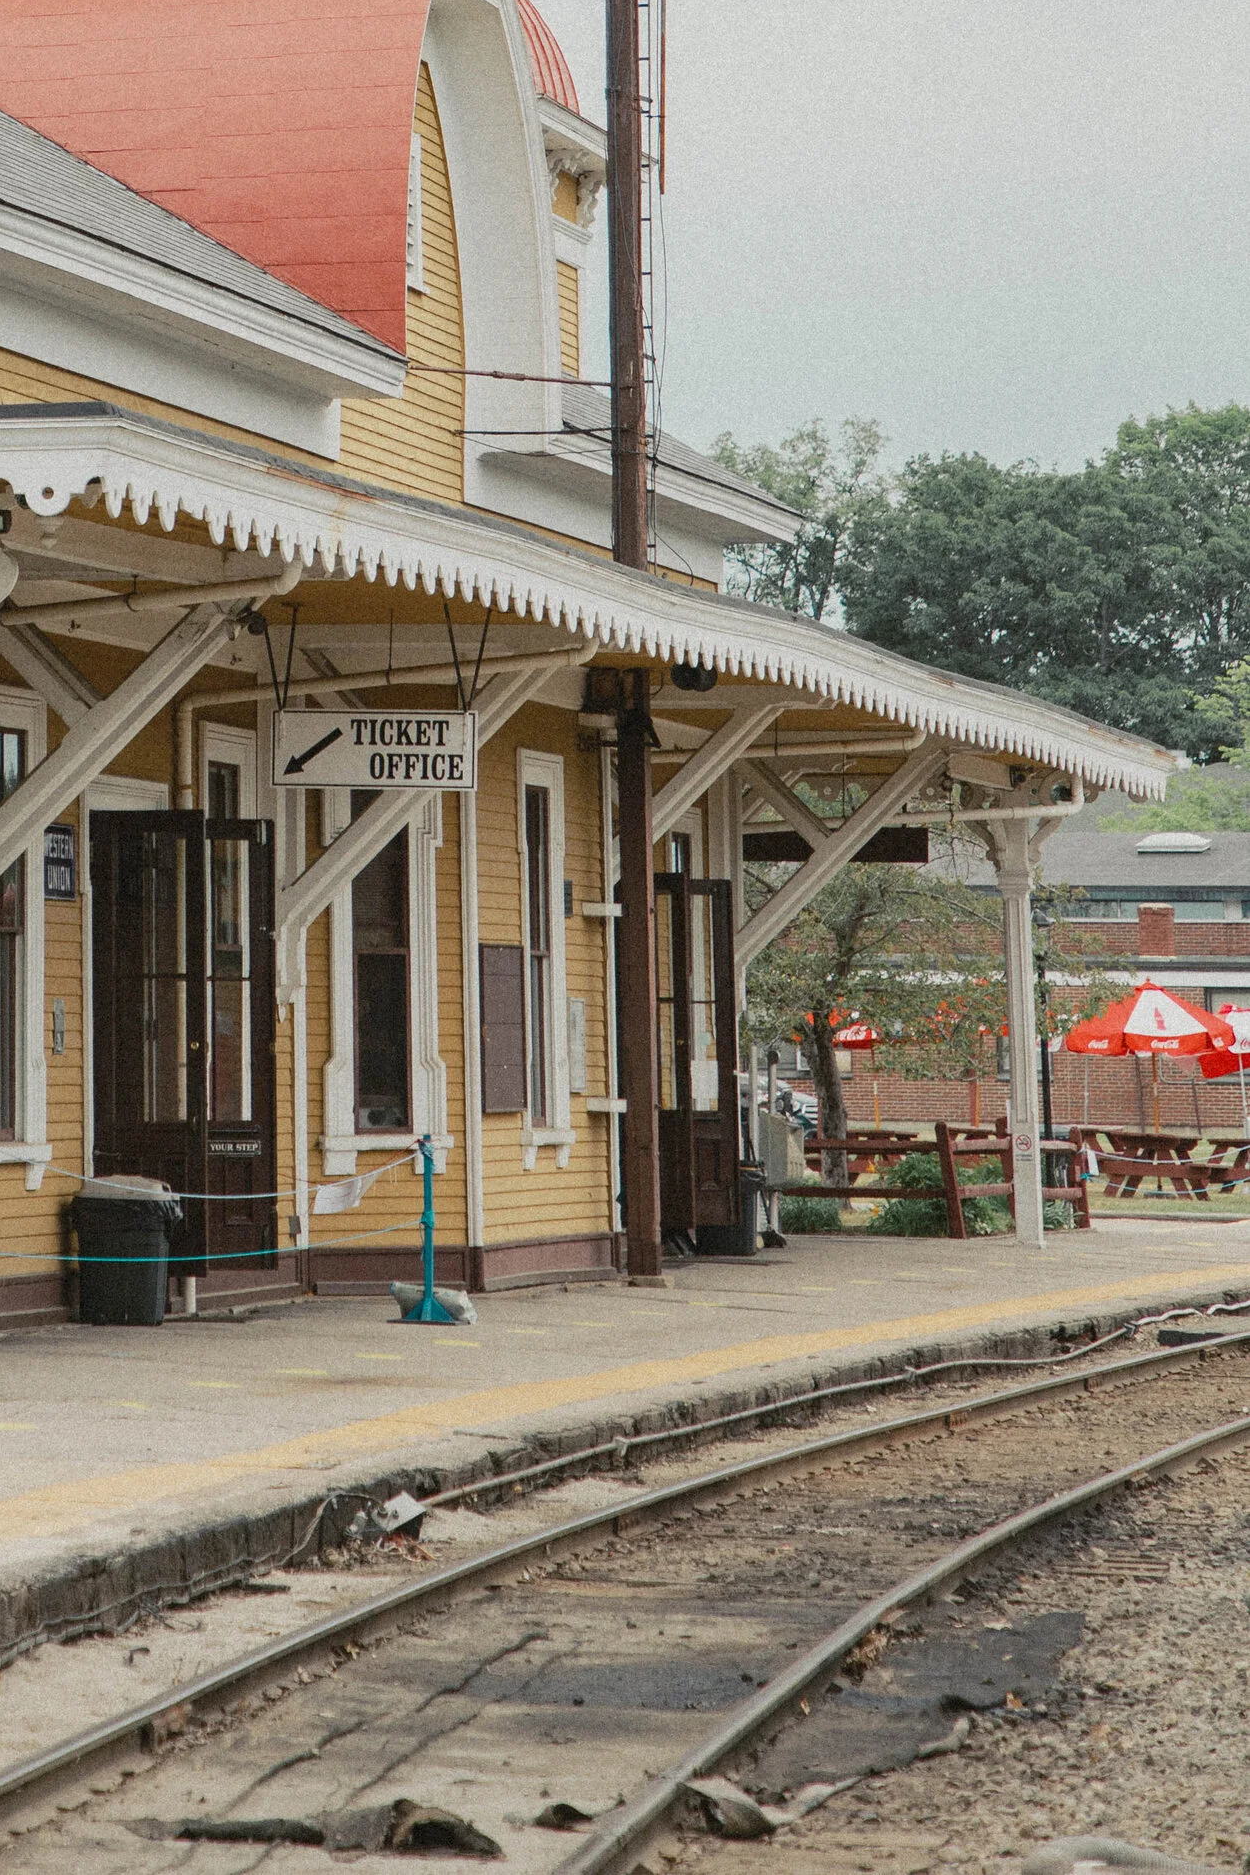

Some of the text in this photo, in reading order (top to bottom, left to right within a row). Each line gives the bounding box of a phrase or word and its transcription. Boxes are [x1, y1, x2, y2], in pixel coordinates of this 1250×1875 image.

[351, 719, 449, 746] TICKET
[370, 752, 464, 781] OFFICE
[48, 865, 71, 891] UNION
[210, 1143, 258, 1151] YOUR STEP
